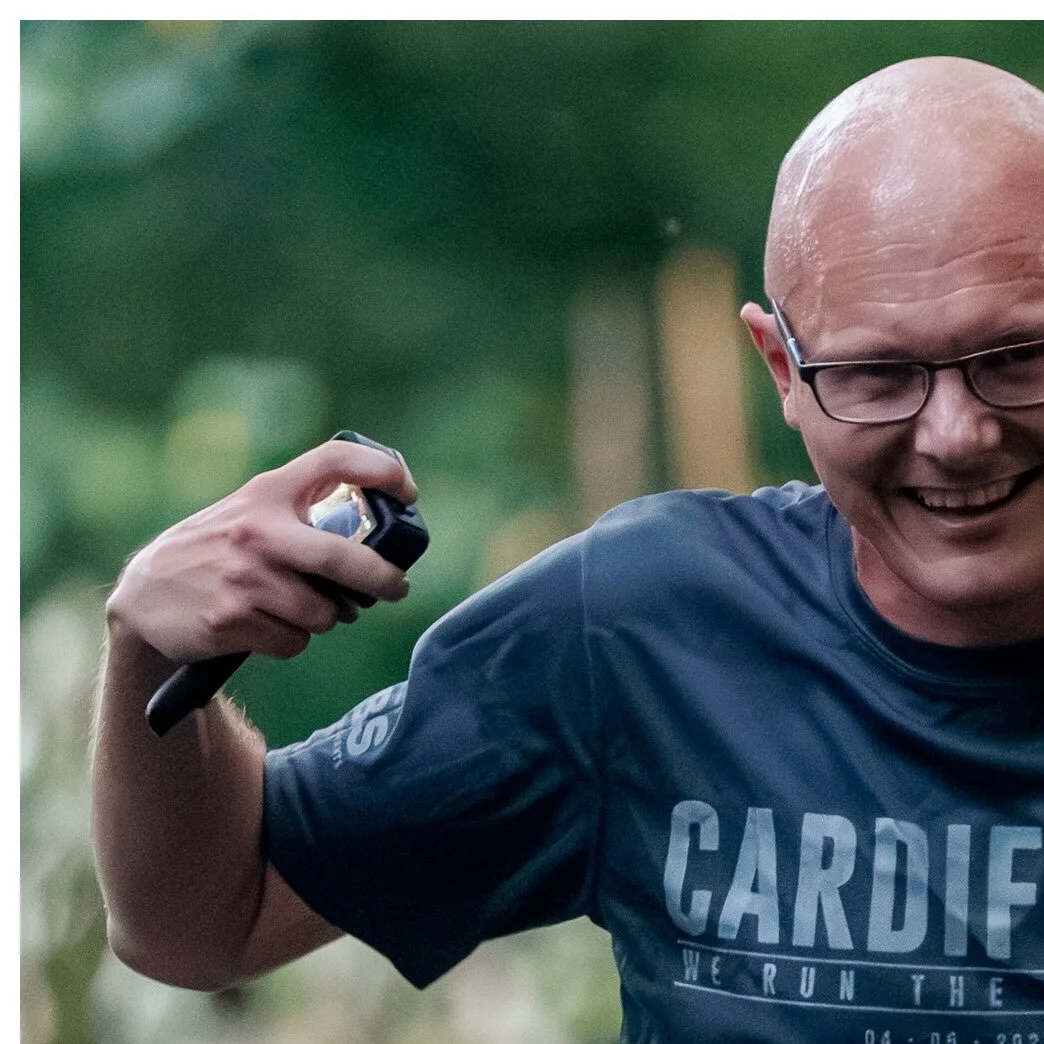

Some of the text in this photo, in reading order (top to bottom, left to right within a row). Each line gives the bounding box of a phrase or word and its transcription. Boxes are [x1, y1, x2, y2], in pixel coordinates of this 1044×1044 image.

[682, 948, 722, 986] WE
[762, 962, 855, 1001] RUN
[910, 973, 1004, 1007] THE
